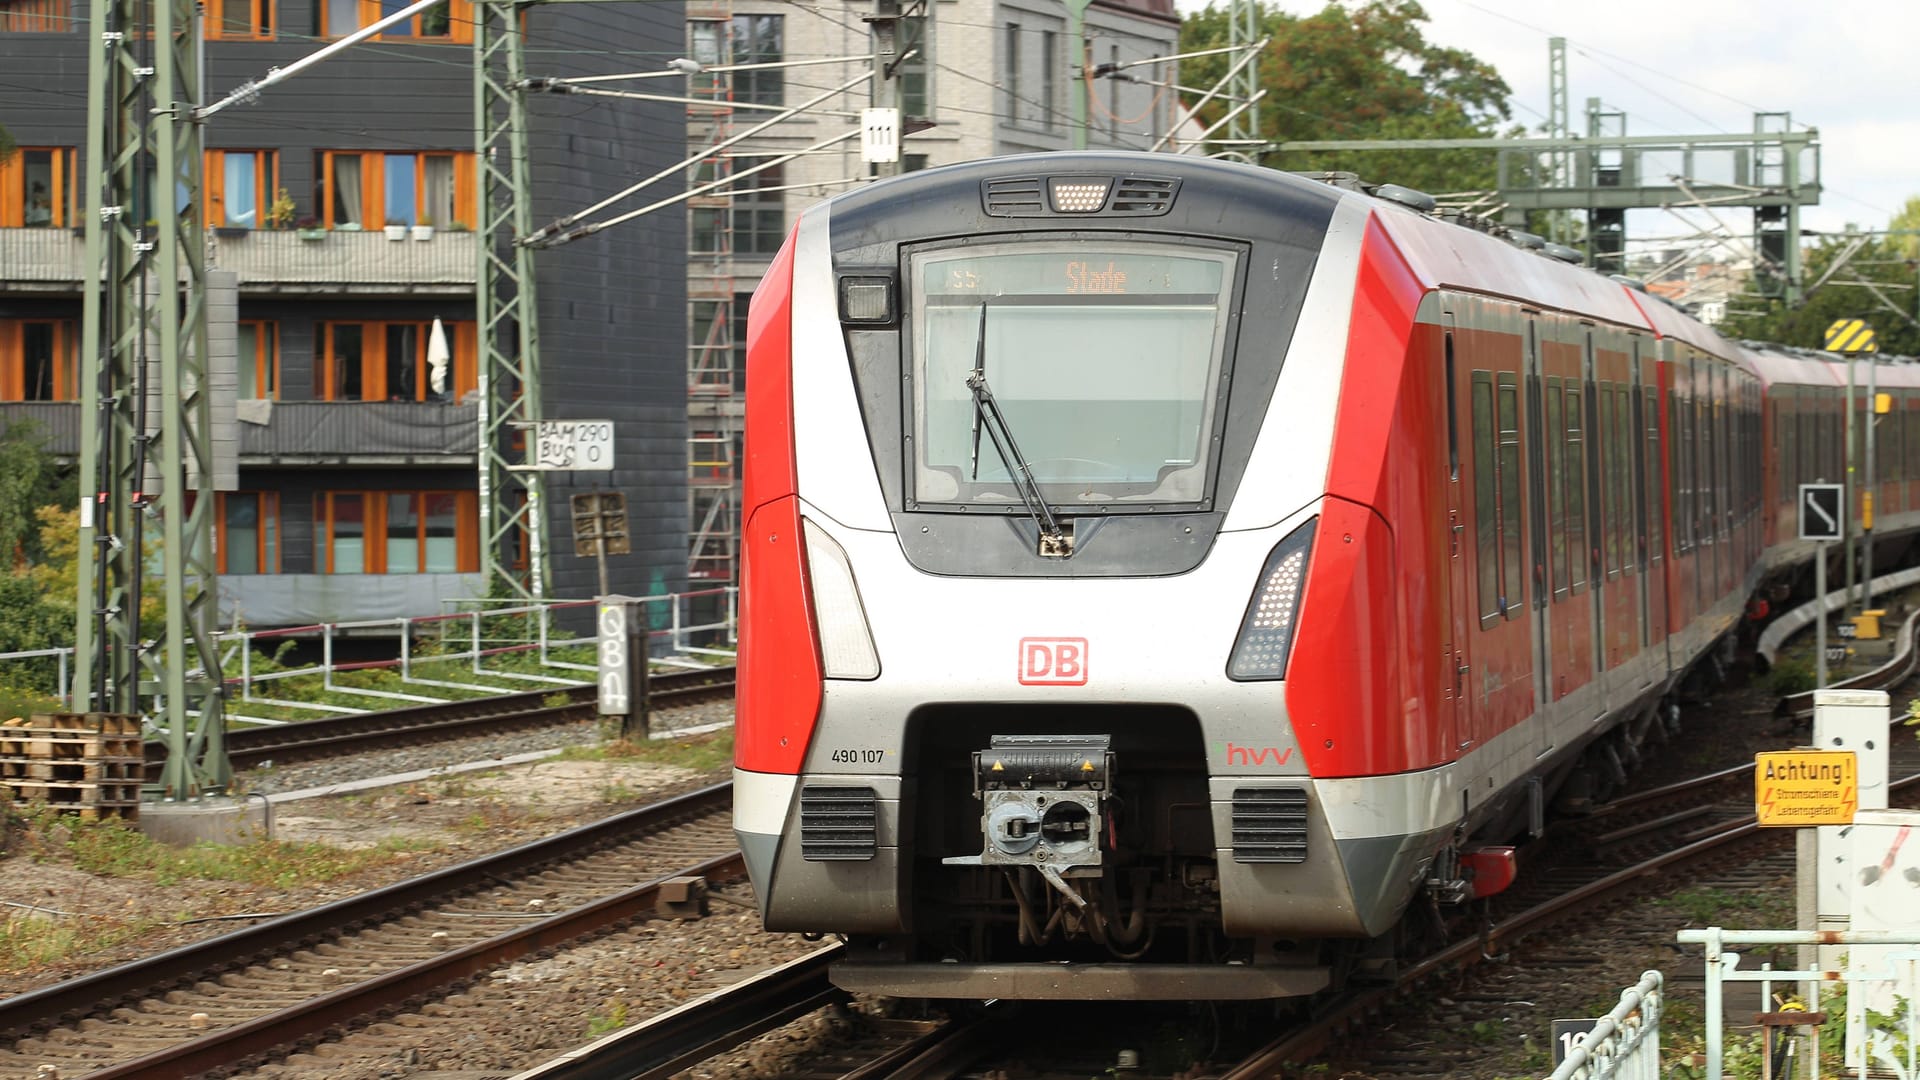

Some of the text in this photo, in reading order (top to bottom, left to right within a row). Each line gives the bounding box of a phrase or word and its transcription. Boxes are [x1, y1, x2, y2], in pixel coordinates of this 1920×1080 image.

[869, 125, 892, 145] 111
[1066, 261, 1127, 293] Stade
[539, 421, 575, 443] BAM
[577, 424, 609, 442] 290
[540, 441, 576, 468] BUS
[1027, 644, 1080, 677] DB
[831, 749, 884, 763] 490 107
[1227, 742, 1293, 766] hvv
[1776, 788, 1840, 800] Stromschiene
[1775, 804, 1841, 818] Lebensgefahr
